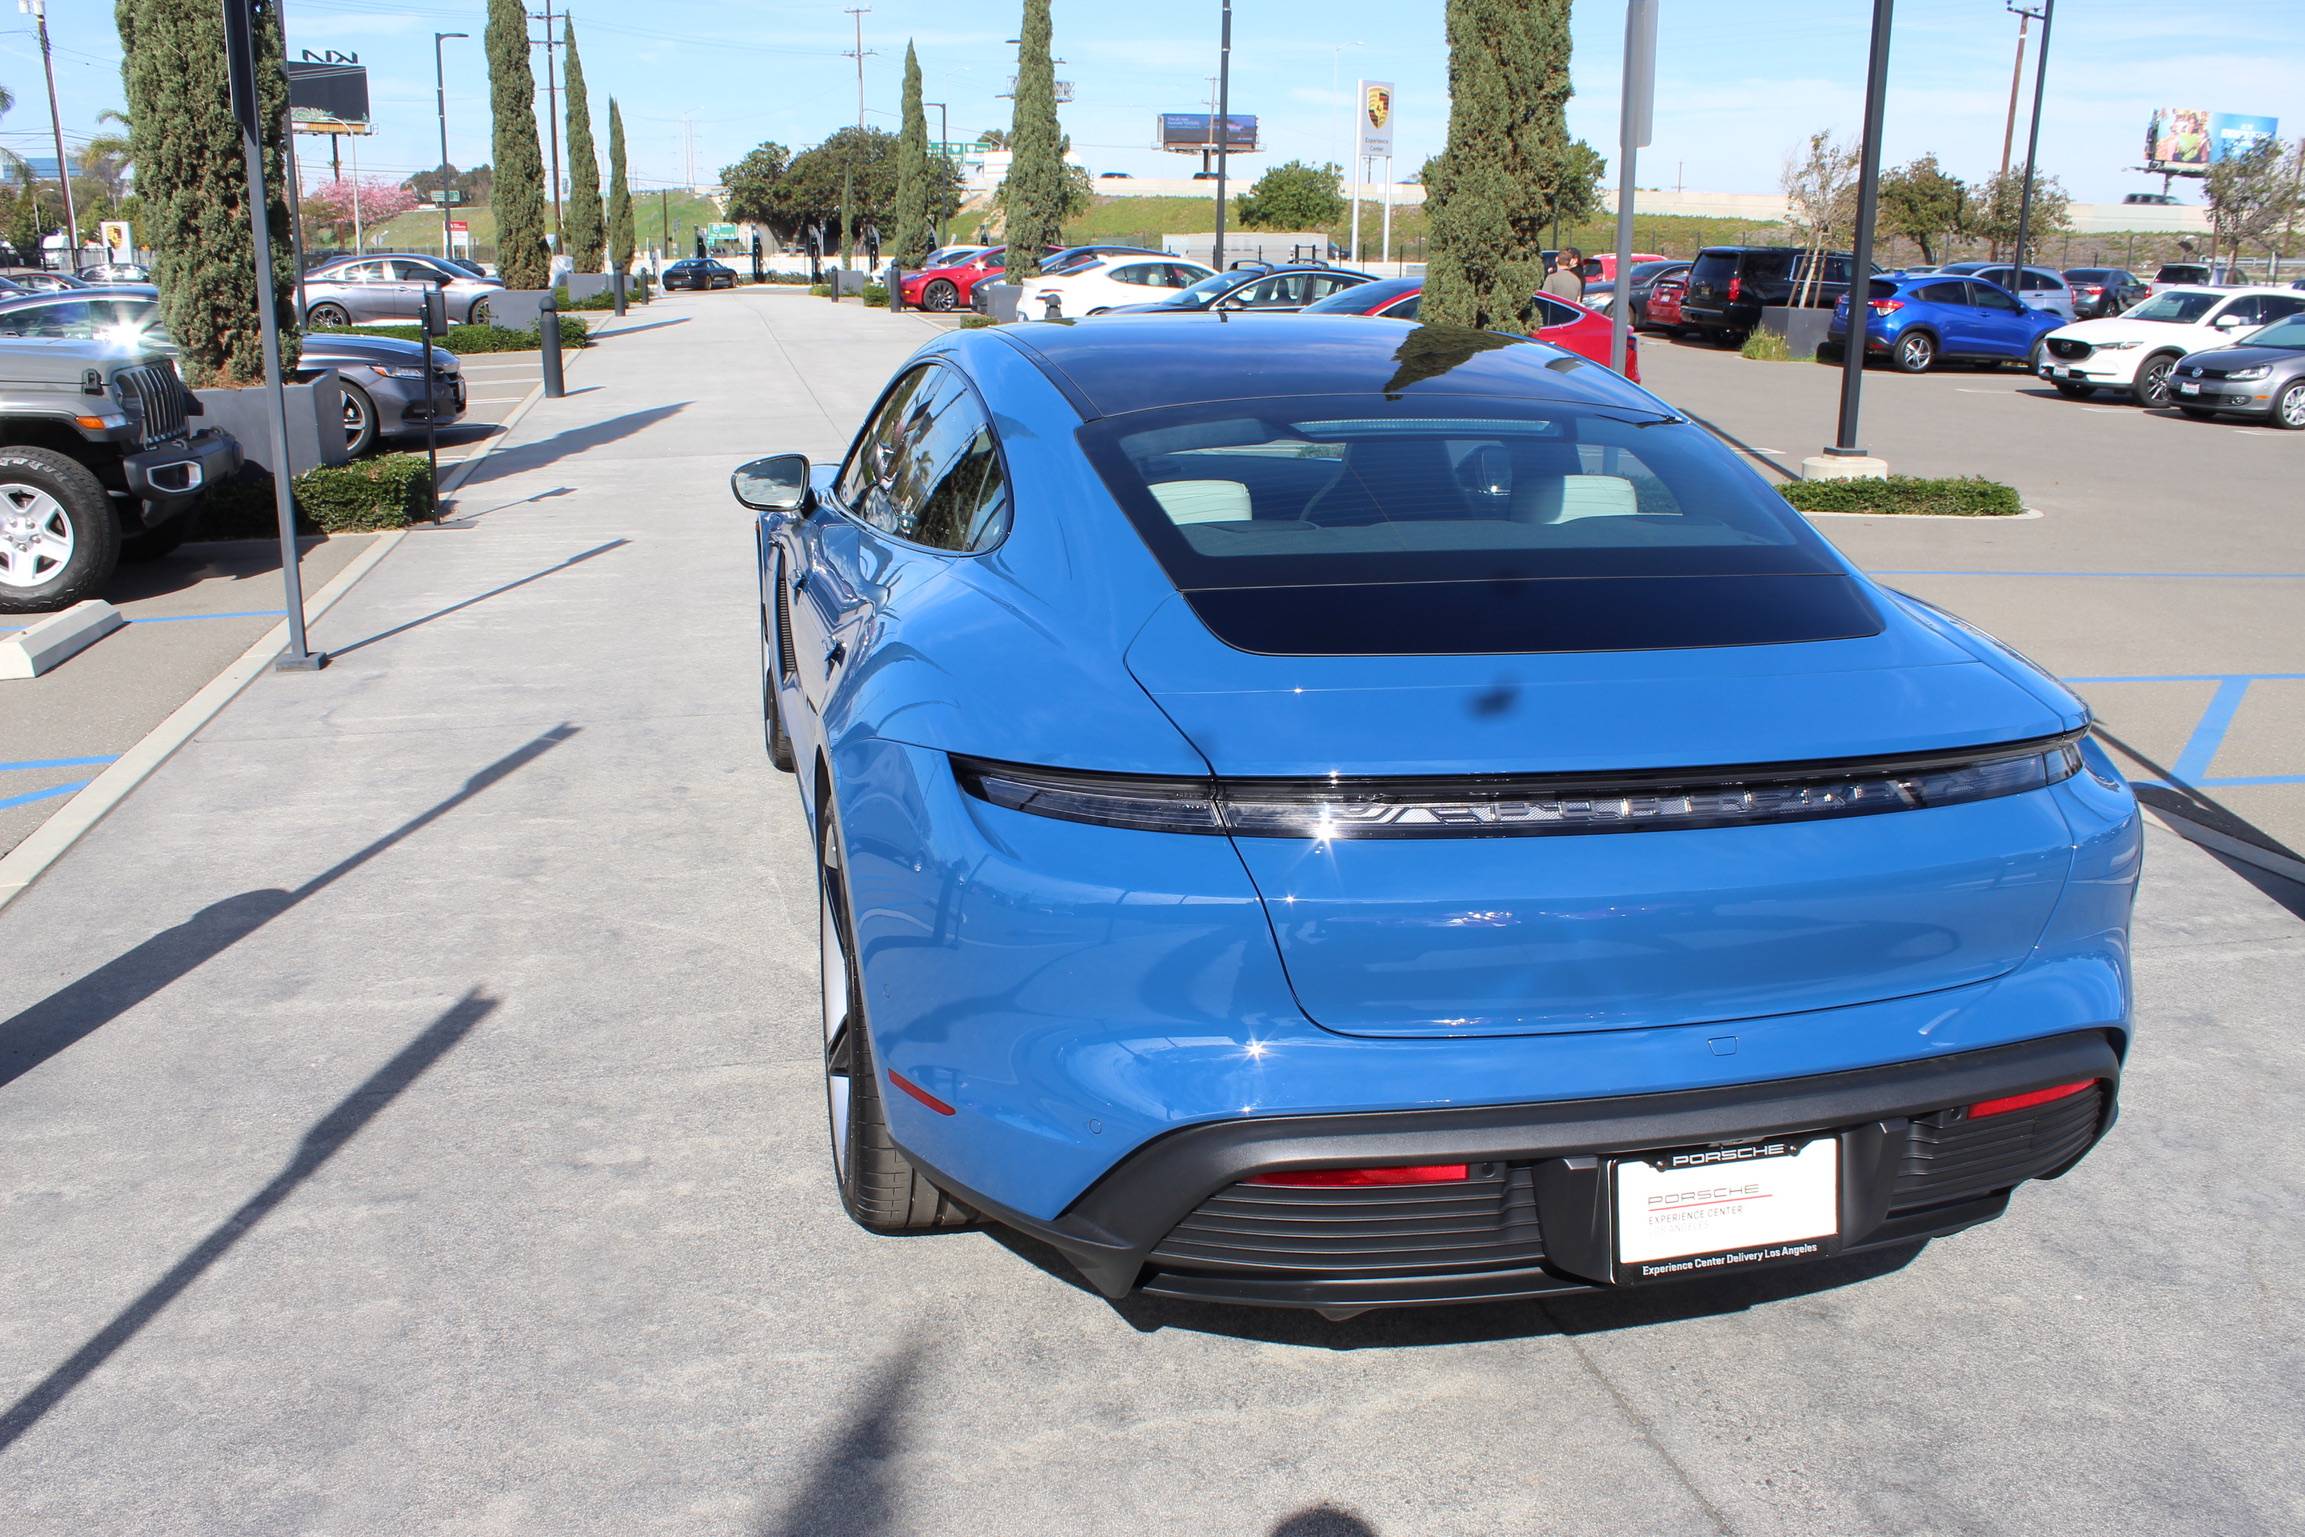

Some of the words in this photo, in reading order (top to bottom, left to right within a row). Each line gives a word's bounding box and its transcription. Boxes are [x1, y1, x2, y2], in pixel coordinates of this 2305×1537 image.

[1673, 1144, 1785, 1166] PORSCHE
[1648, 1184, 1760, 1205] PORSCHE
[1648, 1210, 1704, 1225] EXPERIENCE
[1707, 1205, 1743, 1219] CENTER
[1642, 1261, 1693, 1276] Experience
[1694, 1257, 1725, 1268] Center
[1726, 1252, 1763, 1263] Delivery
[1764, 1248, 1781, 1258] Los
[1781, 1243, 1818, 1256] Angeles
